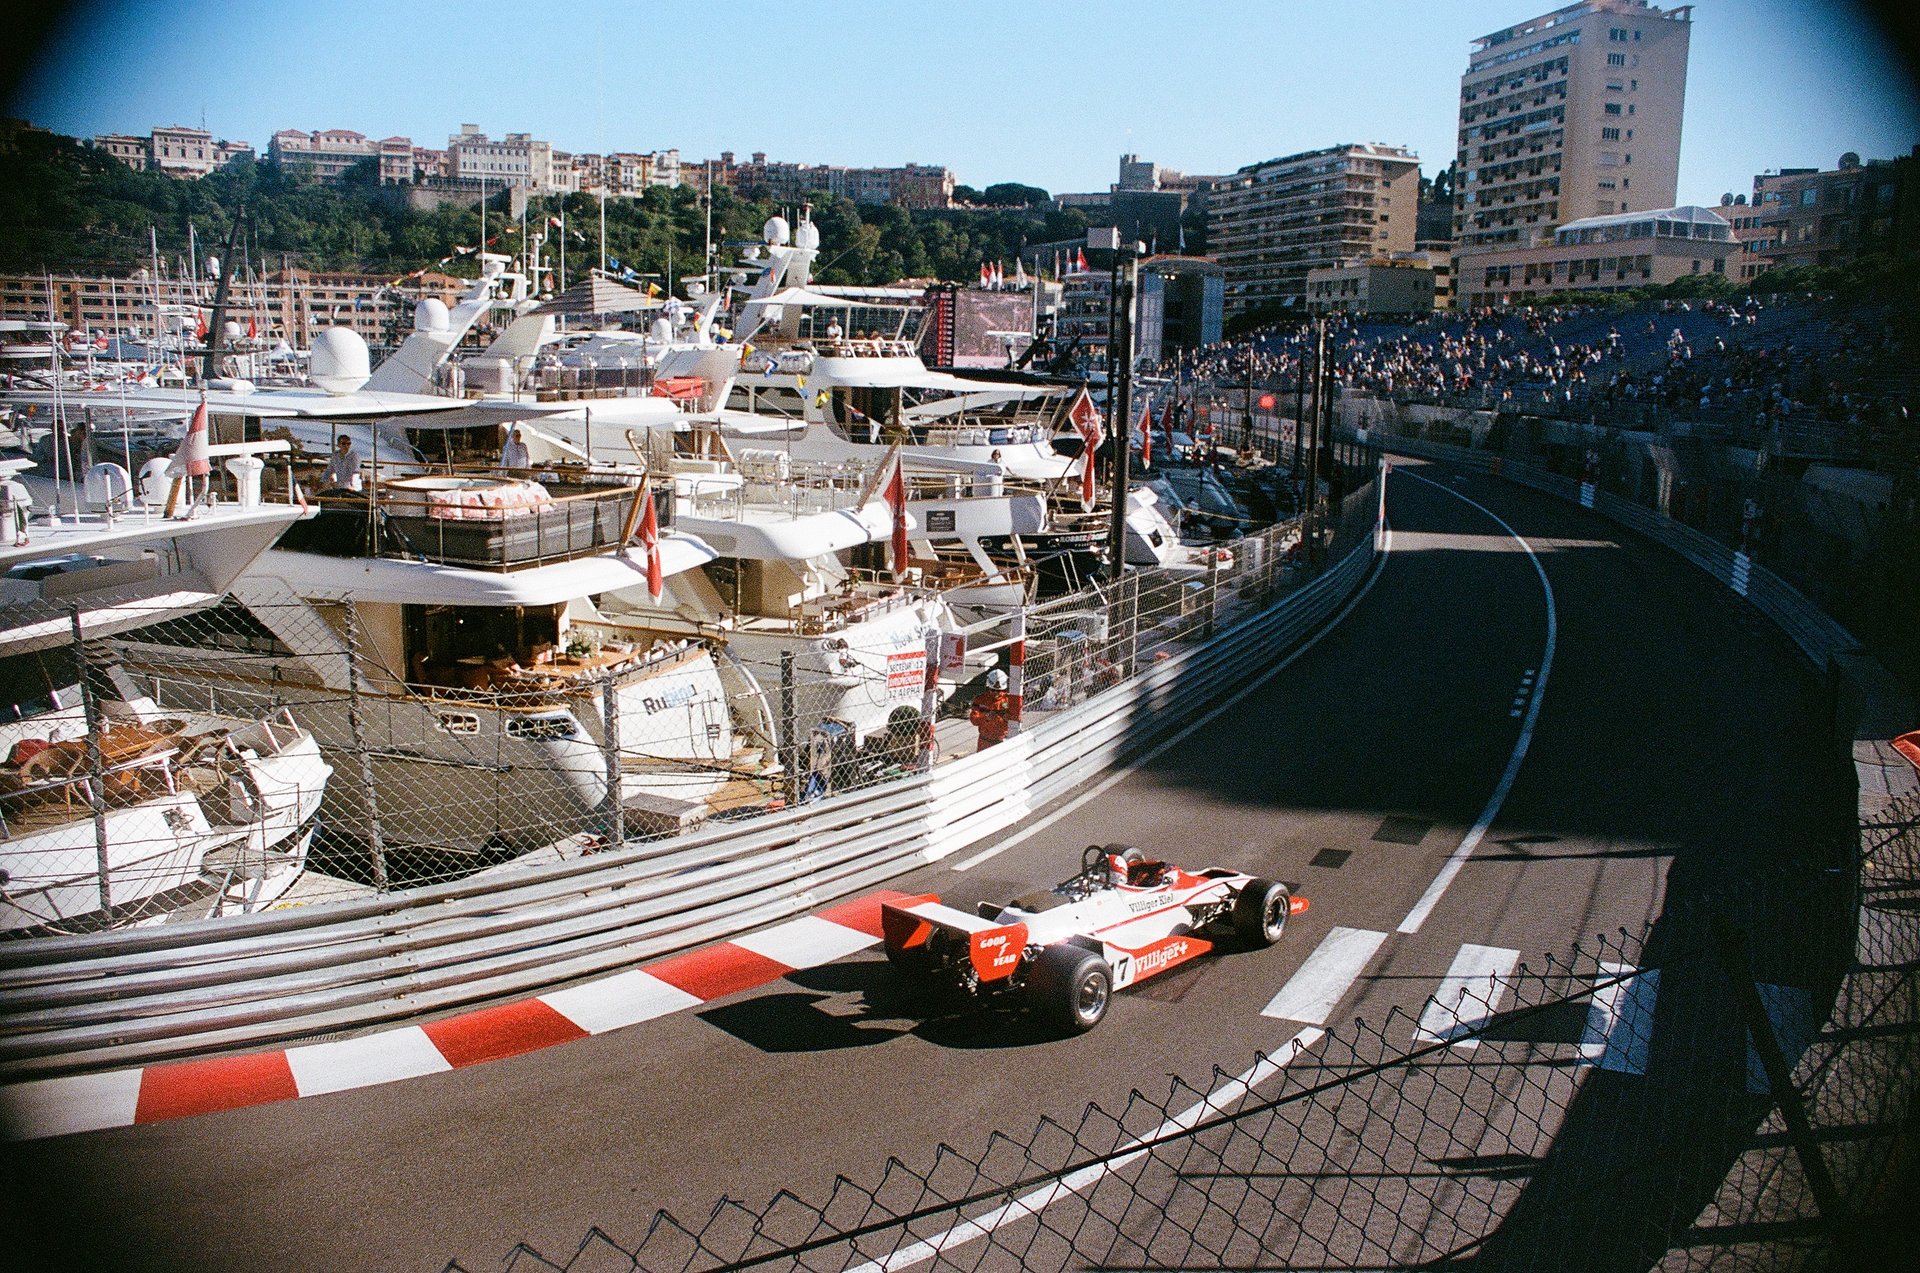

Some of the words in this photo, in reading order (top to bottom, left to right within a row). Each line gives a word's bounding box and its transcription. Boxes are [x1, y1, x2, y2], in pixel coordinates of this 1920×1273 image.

[1128, 899, 1158, 912] Villiger
[980, 936, 1006, 948] GOOD
[994, 954, 1016, 966] YEAR
